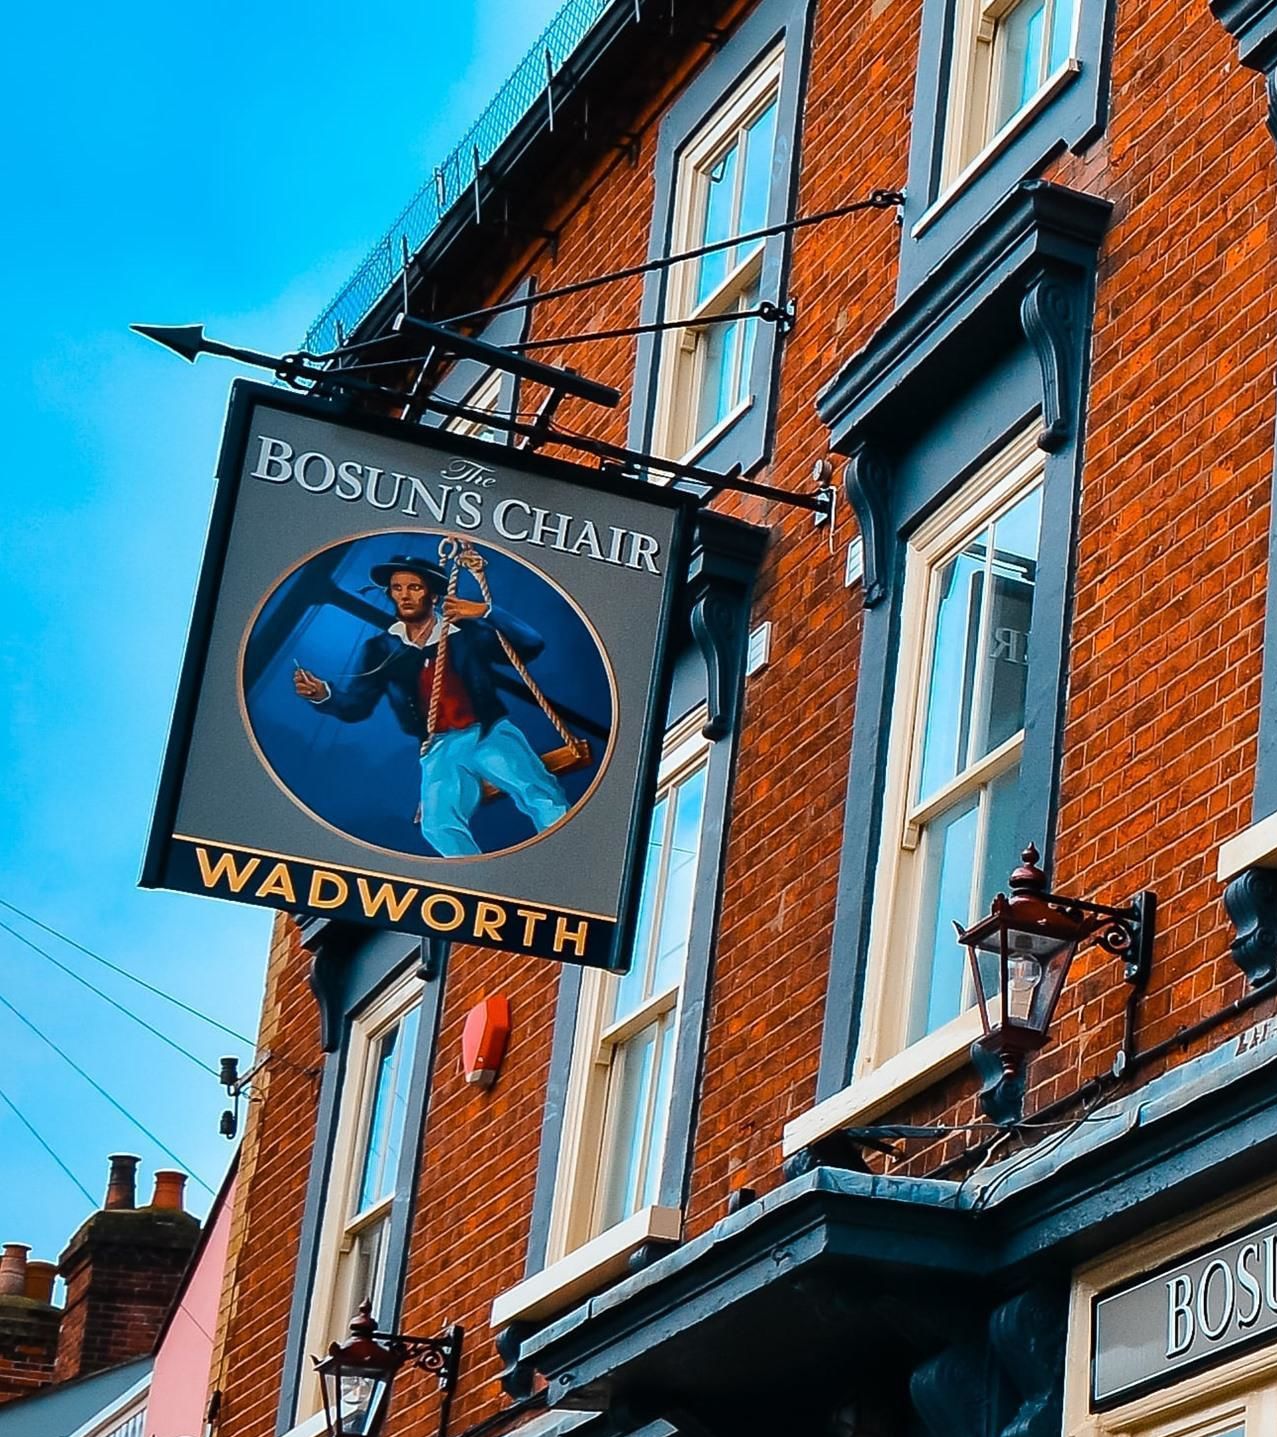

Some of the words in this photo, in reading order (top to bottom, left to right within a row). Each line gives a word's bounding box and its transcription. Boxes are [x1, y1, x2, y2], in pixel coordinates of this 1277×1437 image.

[250, 435, 483, 529] BOSUN'S
[492, 498, 662, 575] CHAIR
[440, 456, 497, 489] The
[195, 847, 589, 958] WADWORTH
